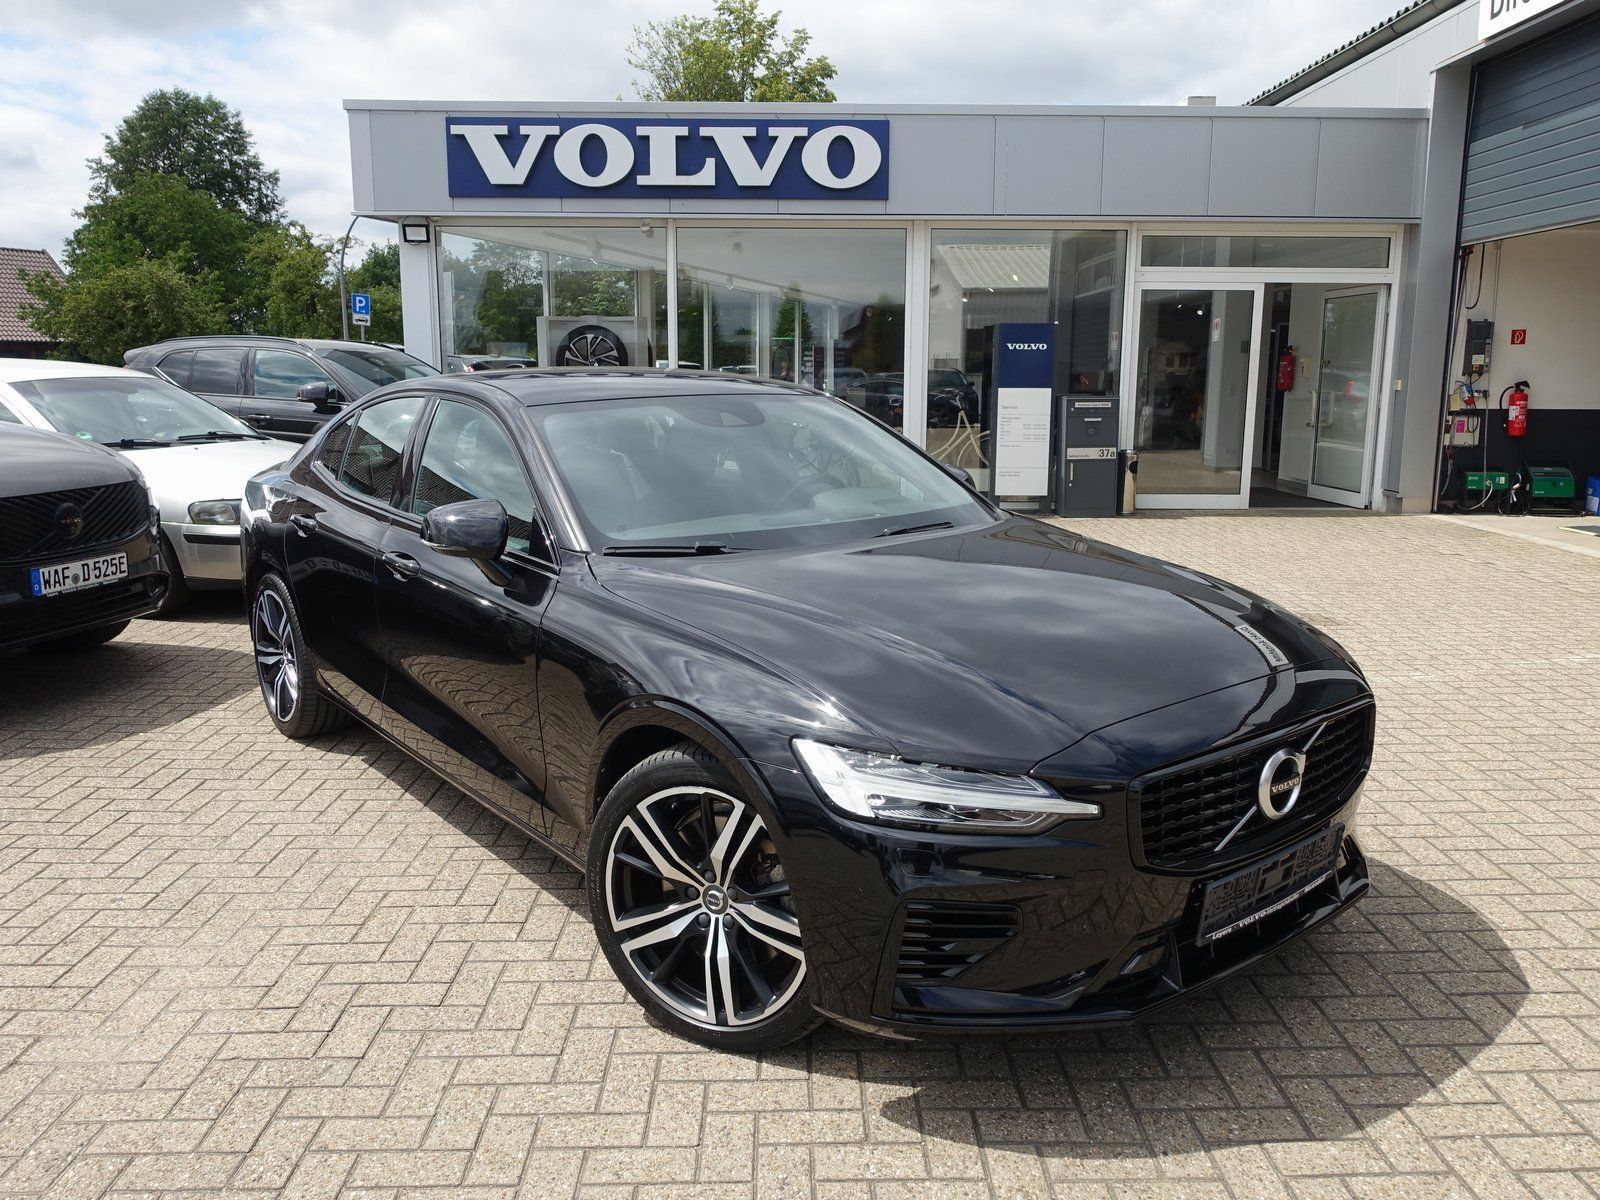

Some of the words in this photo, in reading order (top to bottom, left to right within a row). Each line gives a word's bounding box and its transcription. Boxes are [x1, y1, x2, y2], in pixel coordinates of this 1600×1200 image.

[450, 123, 882, 190] VOLVO
[356, 296, 366, 312] P
[1006, 342, 1048, 351] VOLVO
[1099, 449, 1116, 458] 37a
[42, 567, 70, 590] WAF
[1270, 776, 1300, 794] VOLVO
